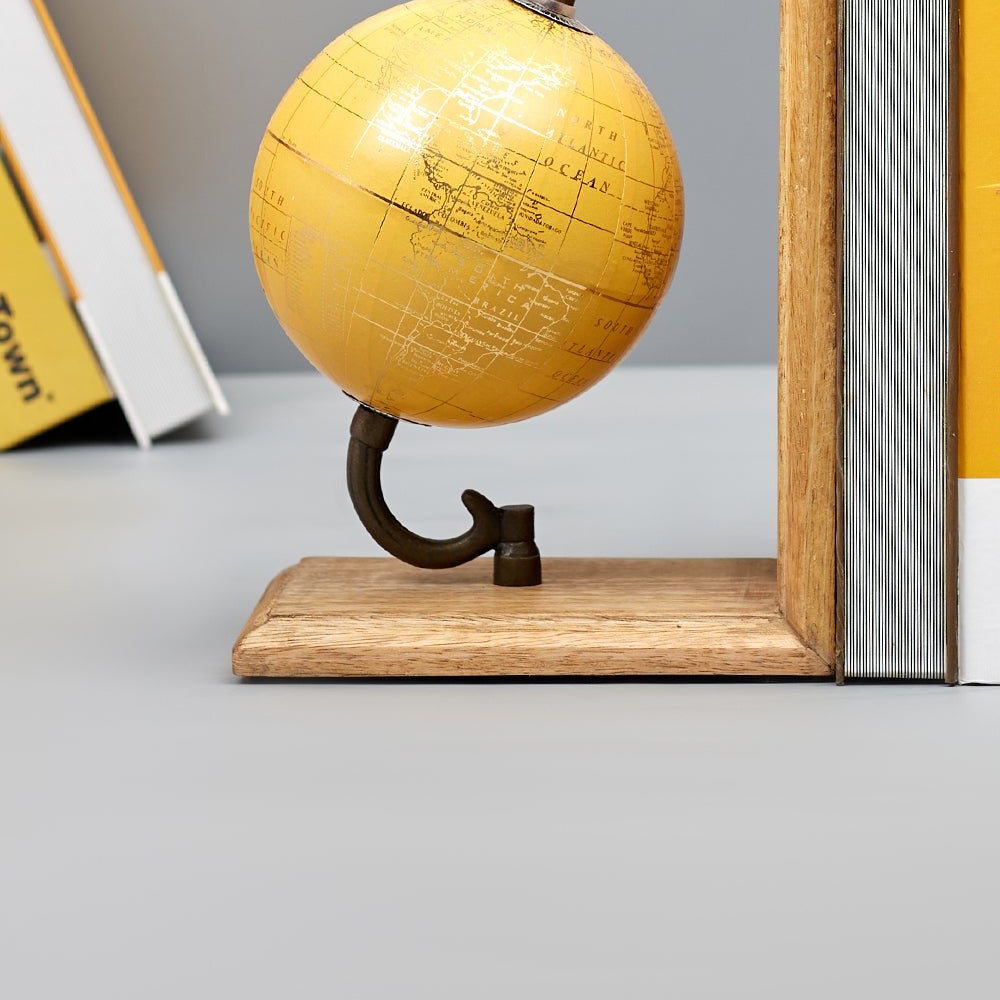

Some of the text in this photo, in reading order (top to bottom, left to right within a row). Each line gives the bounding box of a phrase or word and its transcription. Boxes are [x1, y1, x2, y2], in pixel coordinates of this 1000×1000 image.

[556, 107, 618, 142] NORTH
[543, 156, 611, 194] OCEAN
[473, 296, 519, 321] BRAZIL
